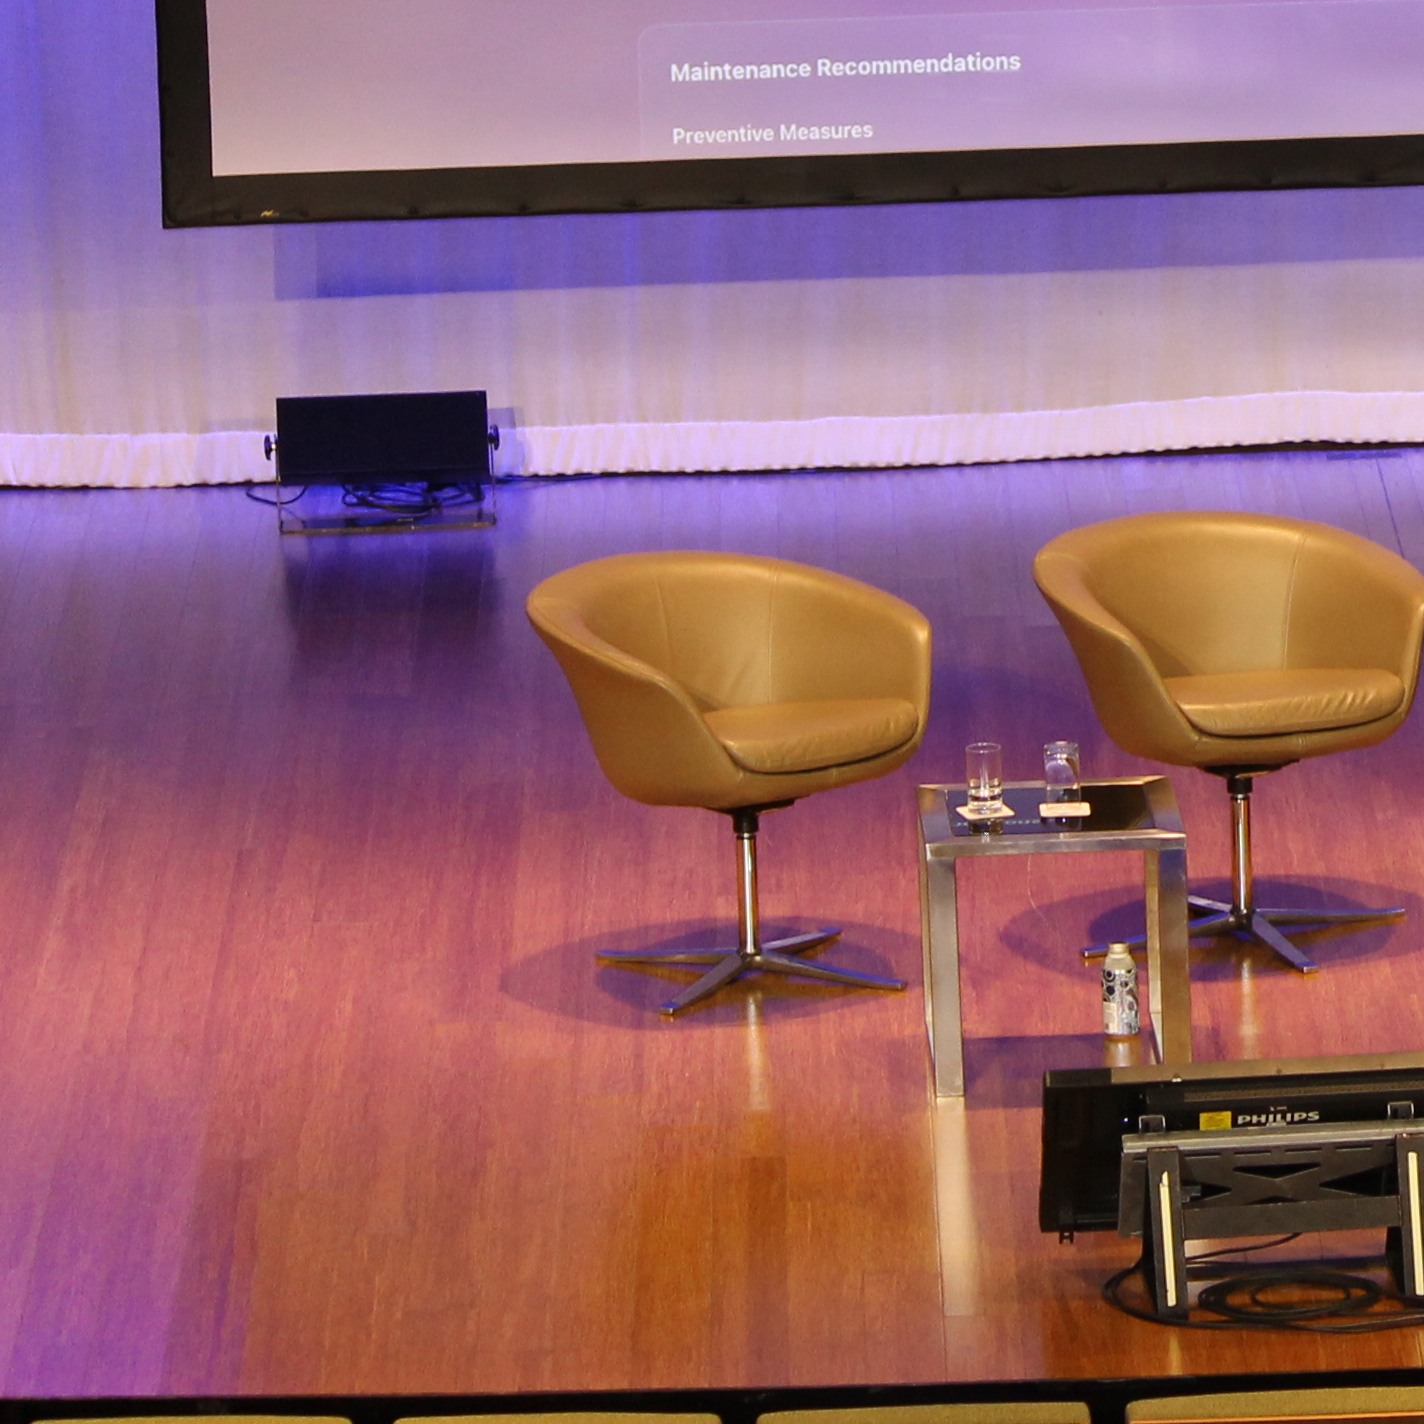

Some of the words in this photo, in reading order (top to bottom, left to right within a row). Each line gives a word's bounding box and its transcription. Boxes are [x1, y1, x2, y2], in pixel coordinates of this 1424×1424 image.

[670, 61, 812, 82] Maintenance
[817, 51, 1022, 77] Recommendations
[672, 123, 775, 145] Preventive
[779, 123, 874, 141] Measures
[1236, 1110, 1321, 1125] PHILIPS
